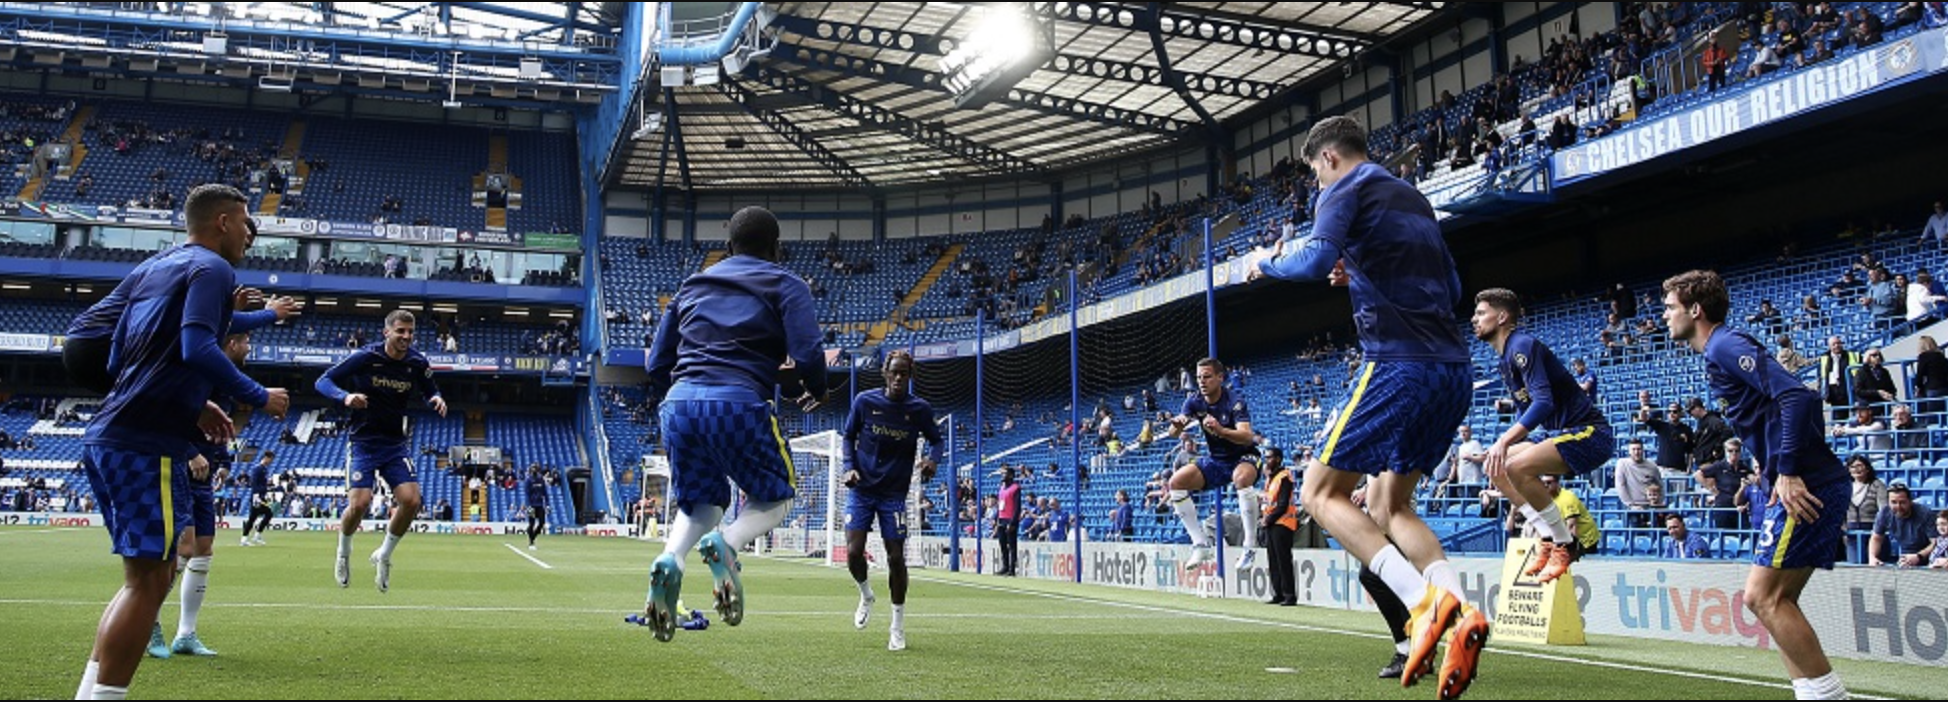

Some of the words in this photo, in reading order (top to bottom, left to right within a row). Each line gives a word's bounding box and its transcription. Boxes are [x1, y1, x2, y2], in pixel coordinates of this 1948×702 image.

[1586, 117, 1684, 173] CHELSEA
[1690, 99, 1741, 143] OUR
[1750, 51, 1880, 125] RELIGION
[1759, 519, 1774, 548] 3
[1093, 551, 1147, 587] Hotel?
[1612, 568, 1770, 651] trivag
[1508, 589, 1544, 602] BEWARE
[1508, 601, 1540, 614] FLYING
[1497, 613, 1547, 628] FOOTBALLS
